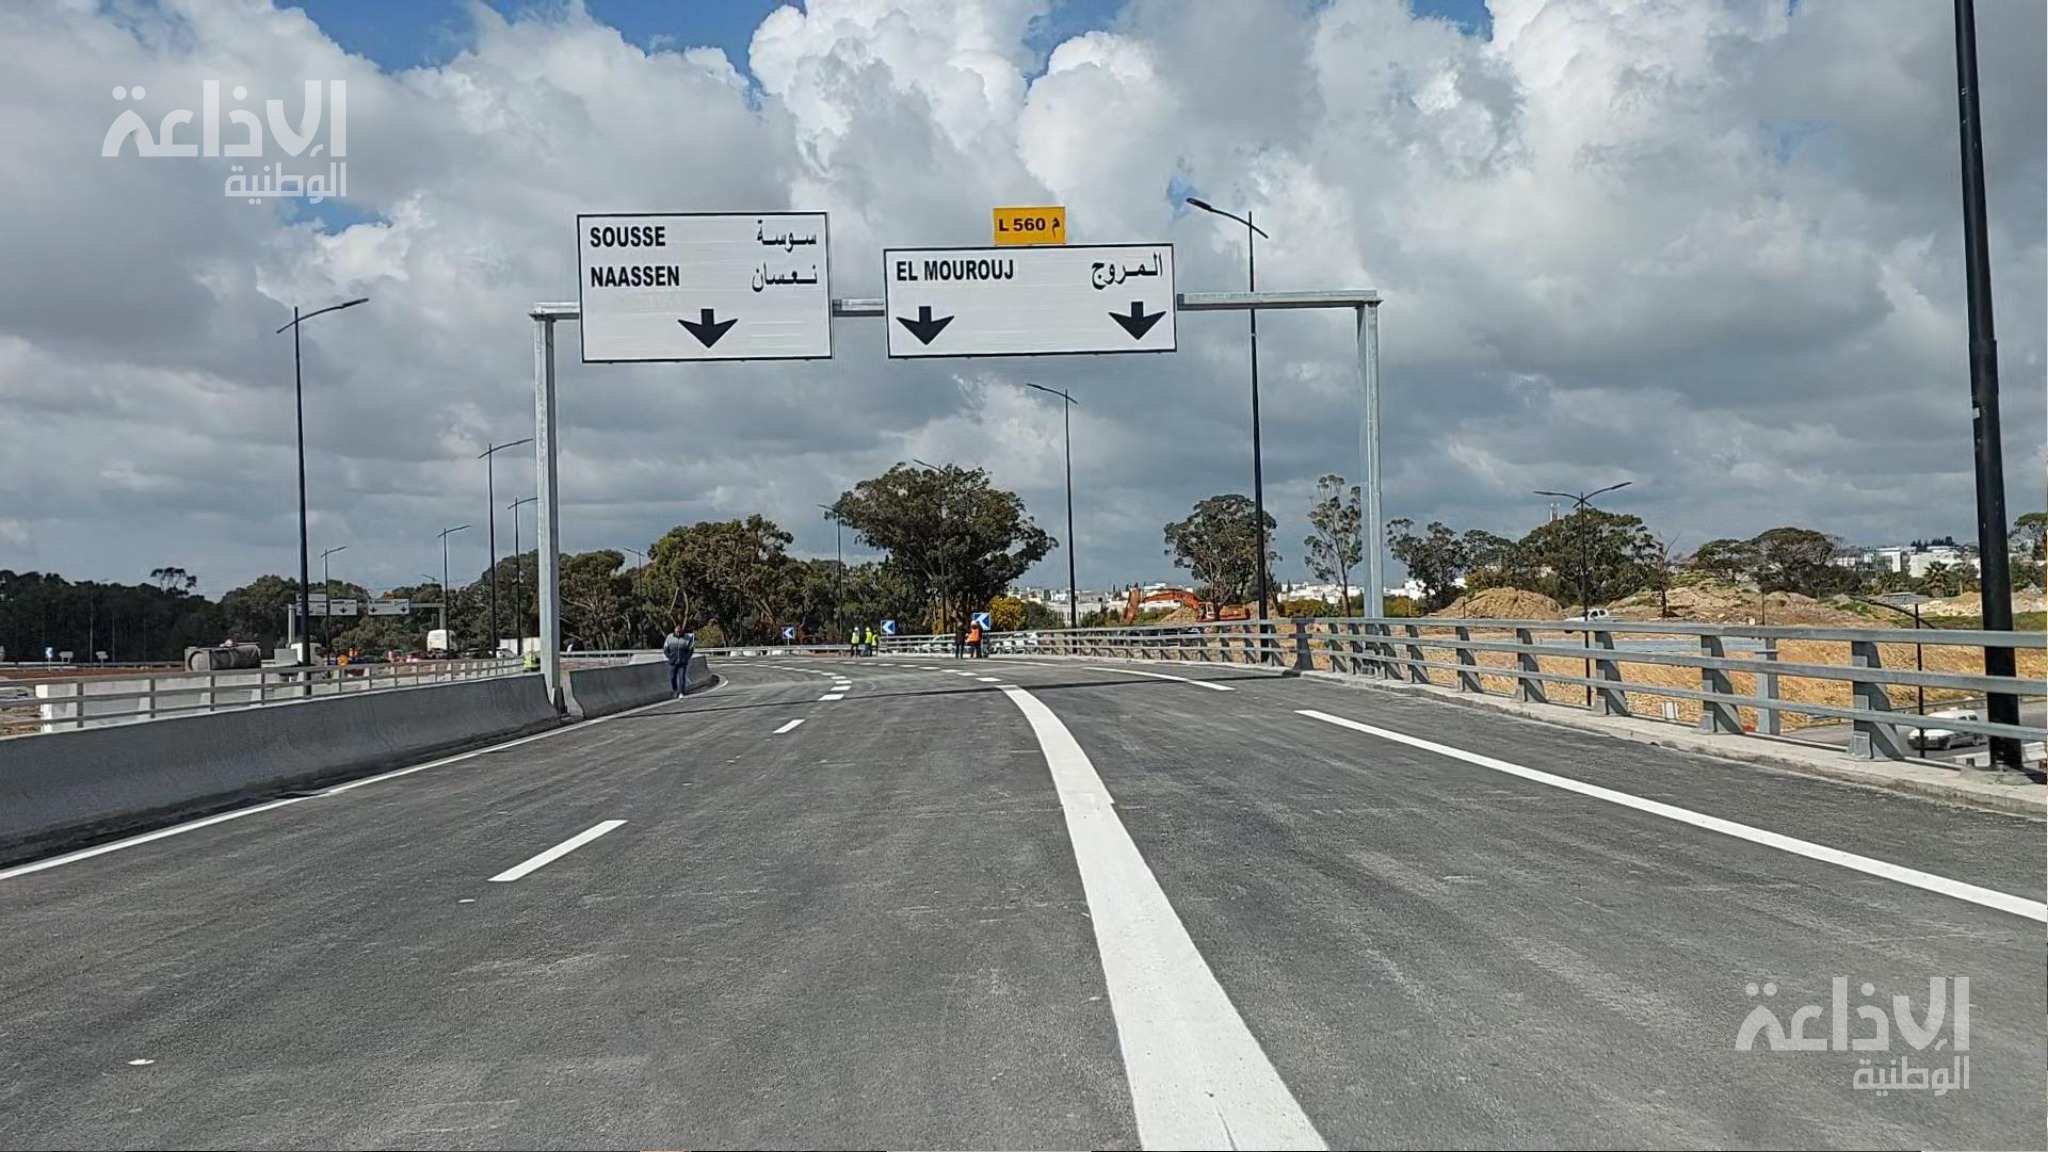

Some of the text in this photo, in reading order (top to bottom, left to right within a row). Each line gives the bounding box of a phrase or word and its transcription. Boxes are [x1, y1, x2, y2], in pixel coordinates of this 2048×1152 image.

[589, 226, 666, 248] SOUSSE
[756, 219, 817, 253] سوسة
[998, 216, 1061, 239] L 560 م
[590, 265, 680, 287] NAASSEN
[751, 262, 818, 293] نعسان
[896, 258, 1014, 281] EL MOUROUJ
[1091, 252, 1164, 290] المروج
